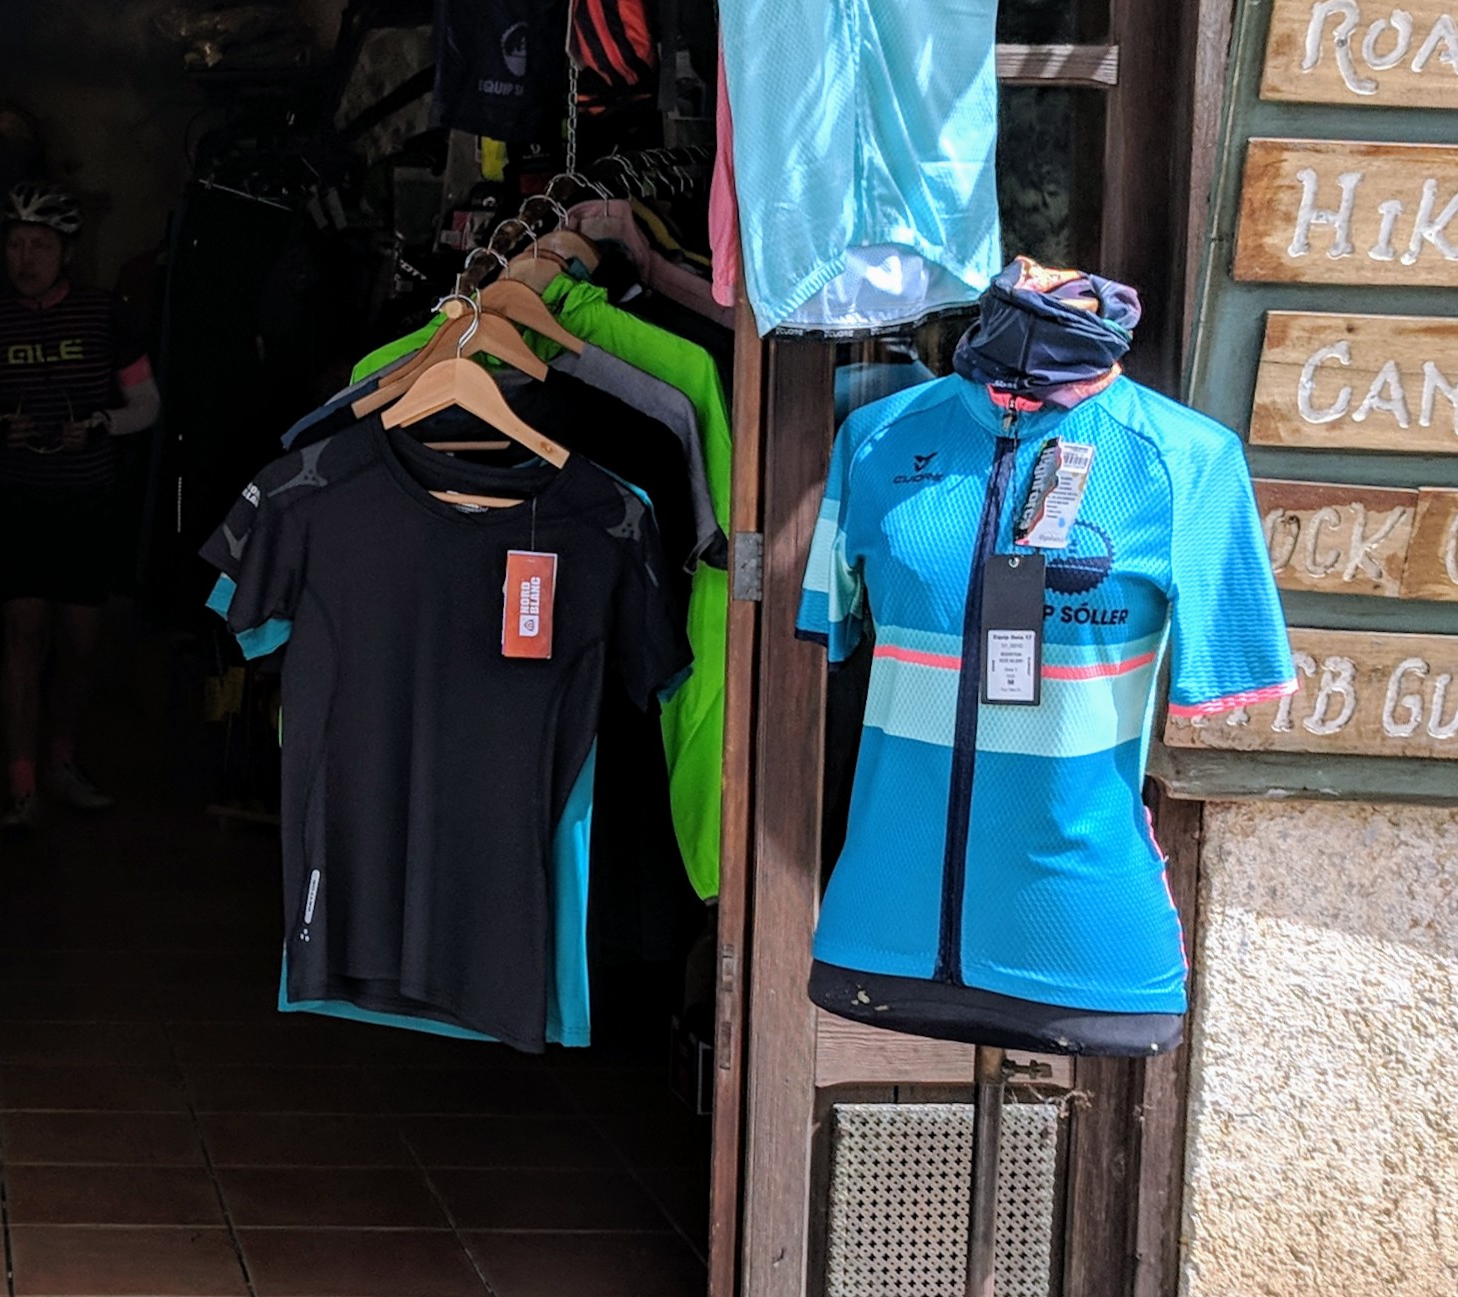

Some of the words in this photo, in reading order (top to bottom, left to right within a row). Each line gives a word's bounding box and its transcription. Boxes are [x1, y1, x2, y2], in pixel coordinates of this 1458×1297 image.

[520, 581, 530, 614] NORD
[530, 576, 541, 615] BLANC
[1060, 603, 1129, 625] SÓLLER
